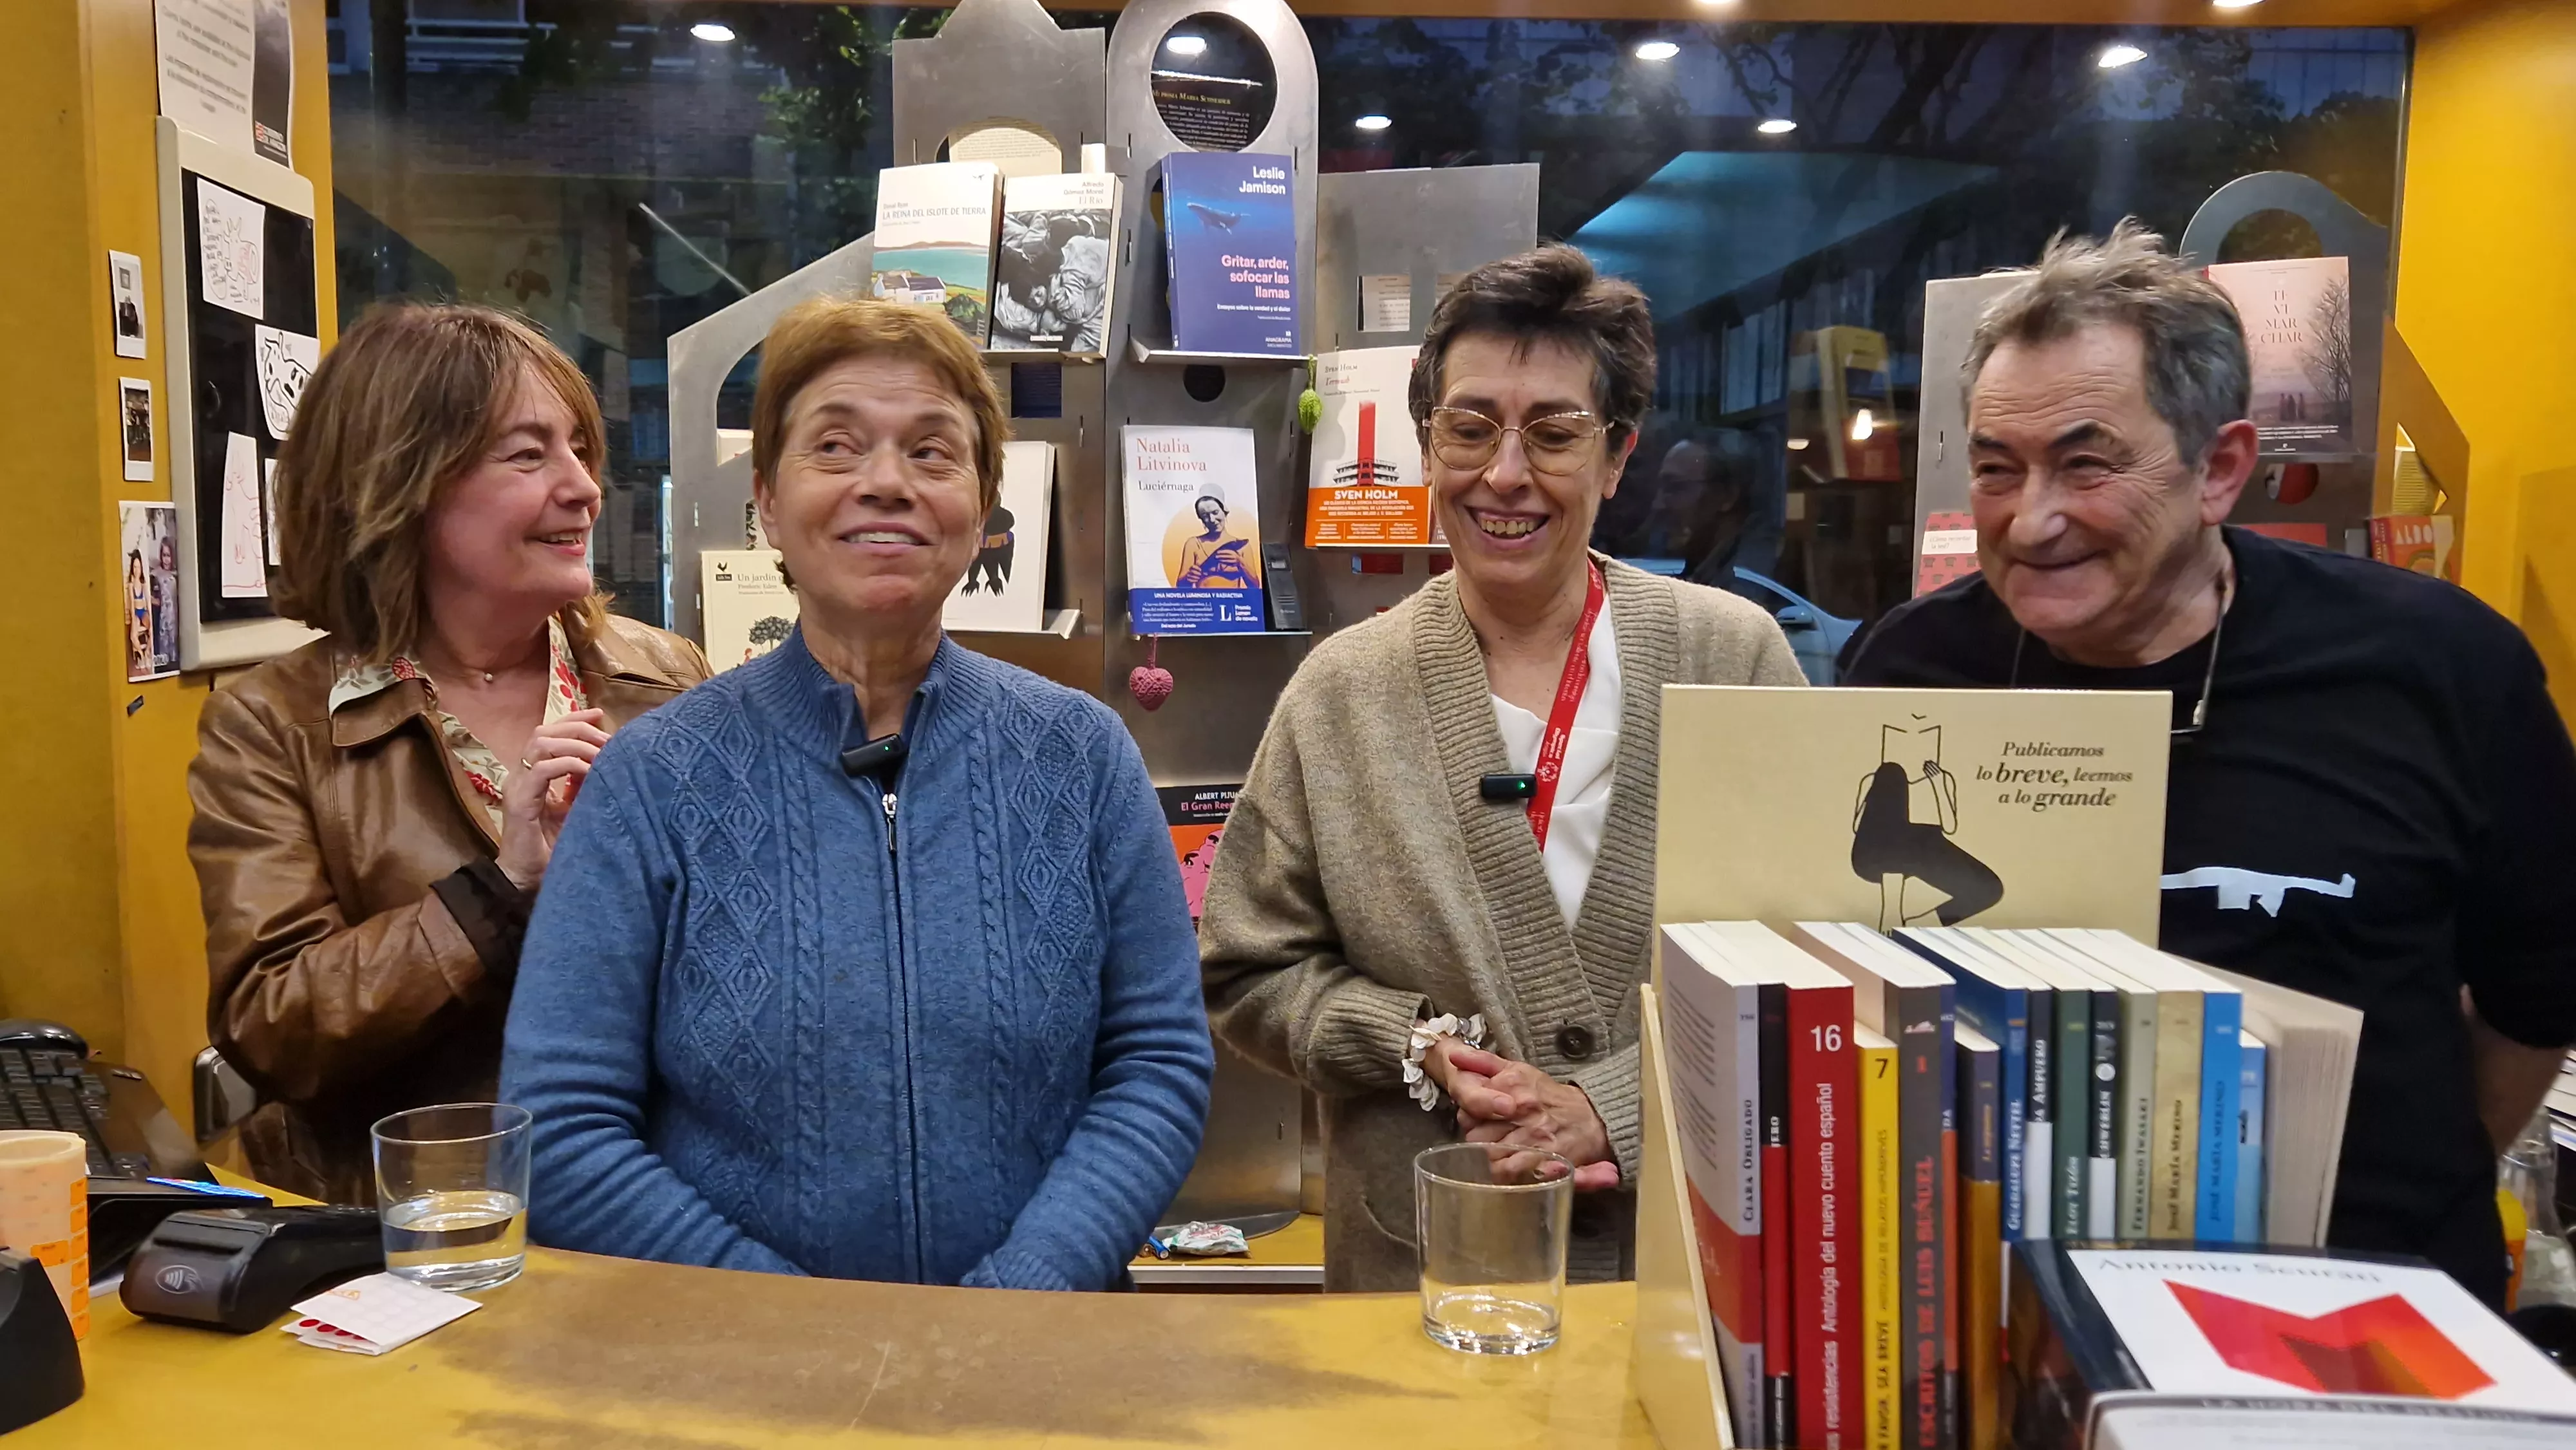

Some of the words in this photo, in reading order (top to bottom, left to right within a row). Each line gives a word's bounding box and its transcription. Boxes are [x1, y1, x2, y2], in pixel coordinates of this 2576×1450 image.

[1253, 166, 1285, 180] Leslie
[1239, 180, 1286, 194] Jamison
[893, 210, 911, 218] REINA
[913, 209, 925, 218] DEL
[926, 208, 949, 216] ISLOTE
[961, 207, 987, 216] TIERRA
[1221, 254, 1256, 269] Gritar,
[1258, 256, 1289, 270] arder,
[1230, 270, 1273, 283] sofocar
[1274, 272, 1290, 285] las
[1255, 285, 1291, 299] llamas
[1217, 303, 1235, 311] Ensayos
[2266, 318, 2298, 329] MAR
[2260, 332, 2303, 344] CHAR
[1137, 437, 1190, 453] Natalia
[1137, 457, 1207, 471] Litvinova
[1139, 480, 1194, 493] Luciérnaga
[1334, 490, 1363, 500] SVEN
[1365, 489, 1398, 500] HOLM
[752, 573, 777, 583] jardín
[1219, 605, 1233, 622] L
[2001, 741, 2105, 757] Publicamos
[1975, 766, 1993, 780] lo
[1995, 762, 2069, 787] breve,
[2072, 767, 2133, 782] leemos
[1181, 802, 1188, 811] El
[1191, 802, 1213, 811] Gran
[1195, 792, 1218, 800] ALBERT
[1998, 792, 2009, 804] a
[2014, 789, 2031, 804] lo
[2031, 787, 2117, 812] grande
[1810, 1024, 1842, 1052] 16
[1875, 1058, 1888, 1079] 7
[2032, 1039, 2046, 1104] AMPUERO
[1815, 1083, 1837, 1138] español
[2213, 1080, 2226, 1138] MERINO
[1743, 1099, 1754, 1170] OBLIGADO
[2007, 1099, 2022, 1151] NETTEL
[2134, 1097, 2148, 1155] IWASAKI
[1818, 1142, 1835, 1191] cuento
[1743, 1176, 1754, 1221] CLARA
[1911, 1154, 1935, 1243] BUÑUEL
[2131, 1159, 2145, 1231] FERNANDO
[1820, 1194, 1836, 1237] nuevo
[1819, 1241, 1836, 1263] del
[1917, 1247, 1935, 1297] LUIS
[2099, 1258, 2242, 1274] Antonio
[1818, 1266, 1841, 1333] Antología
[1917, 1304, 1936, 1333] DE
[1821, 1341, 1840, 1428] resistencias
